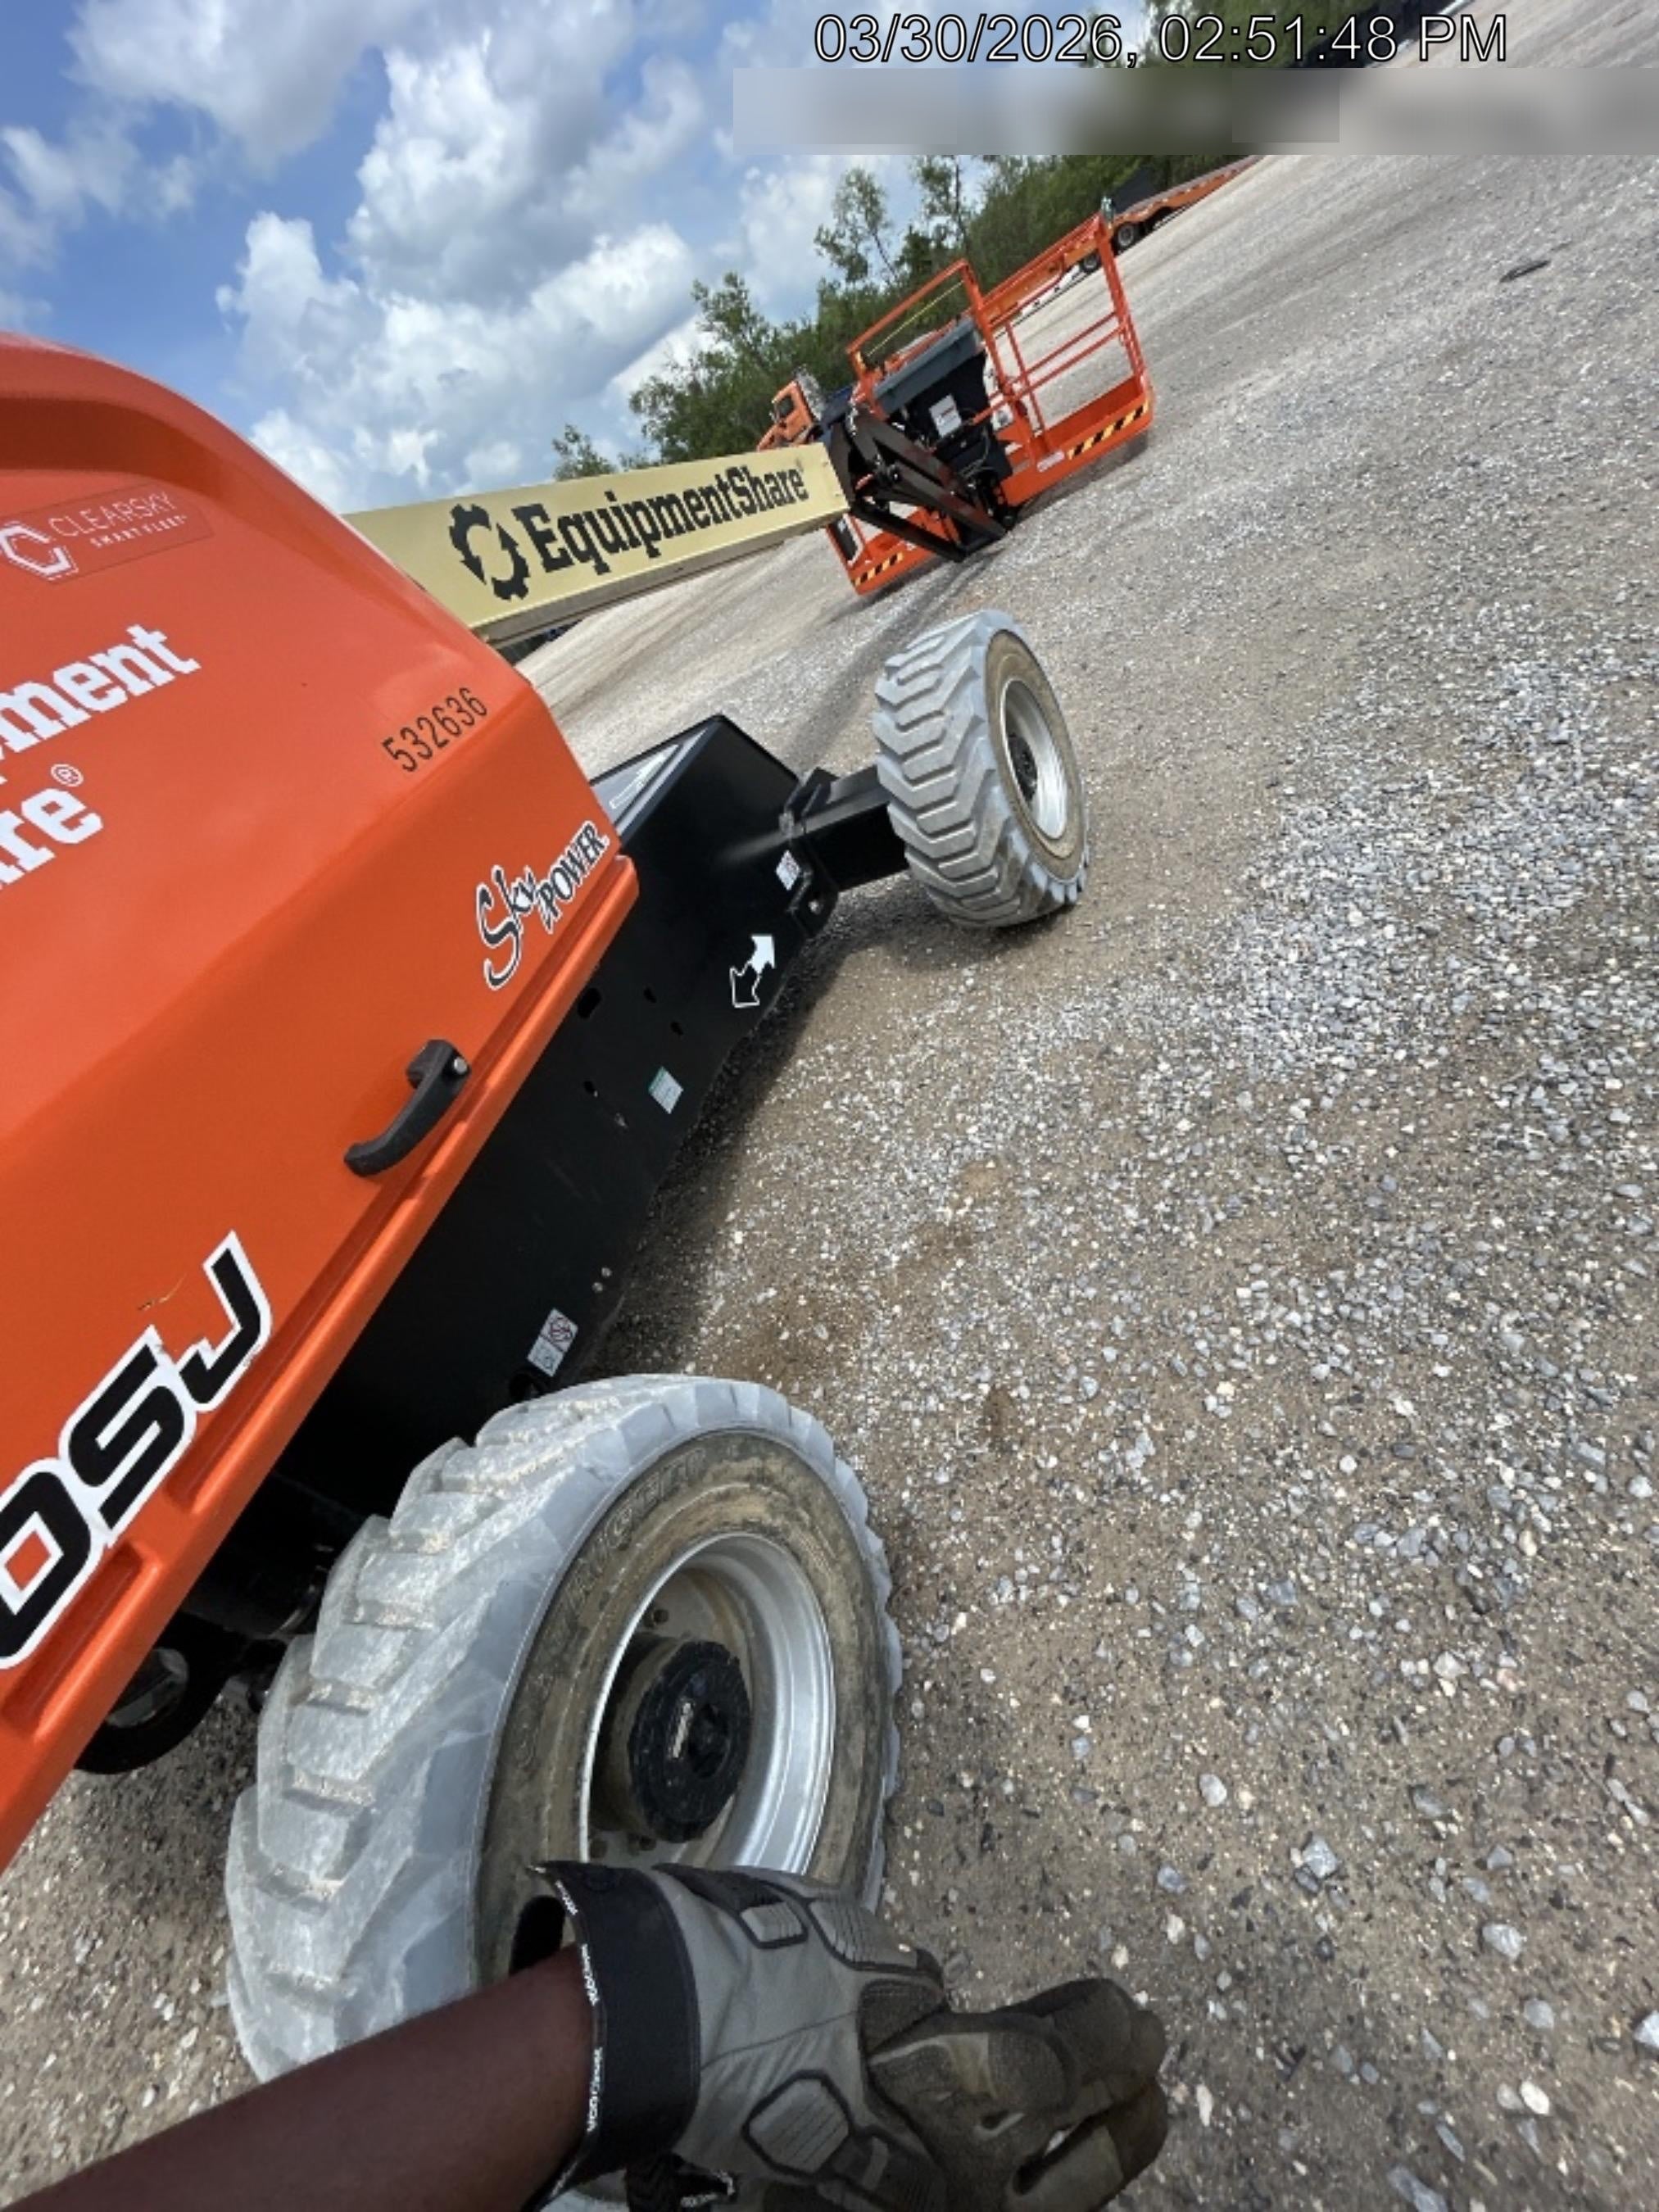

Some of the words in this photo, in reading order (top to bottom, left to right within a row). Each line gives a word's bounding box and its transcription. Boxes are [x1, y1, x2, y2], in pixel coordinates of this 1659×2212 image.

[48, 491, 178, 537] CLEARSKY
[511, 465, 809, 575] EquipmentShare
[381, 687, 488, 773] 532636
